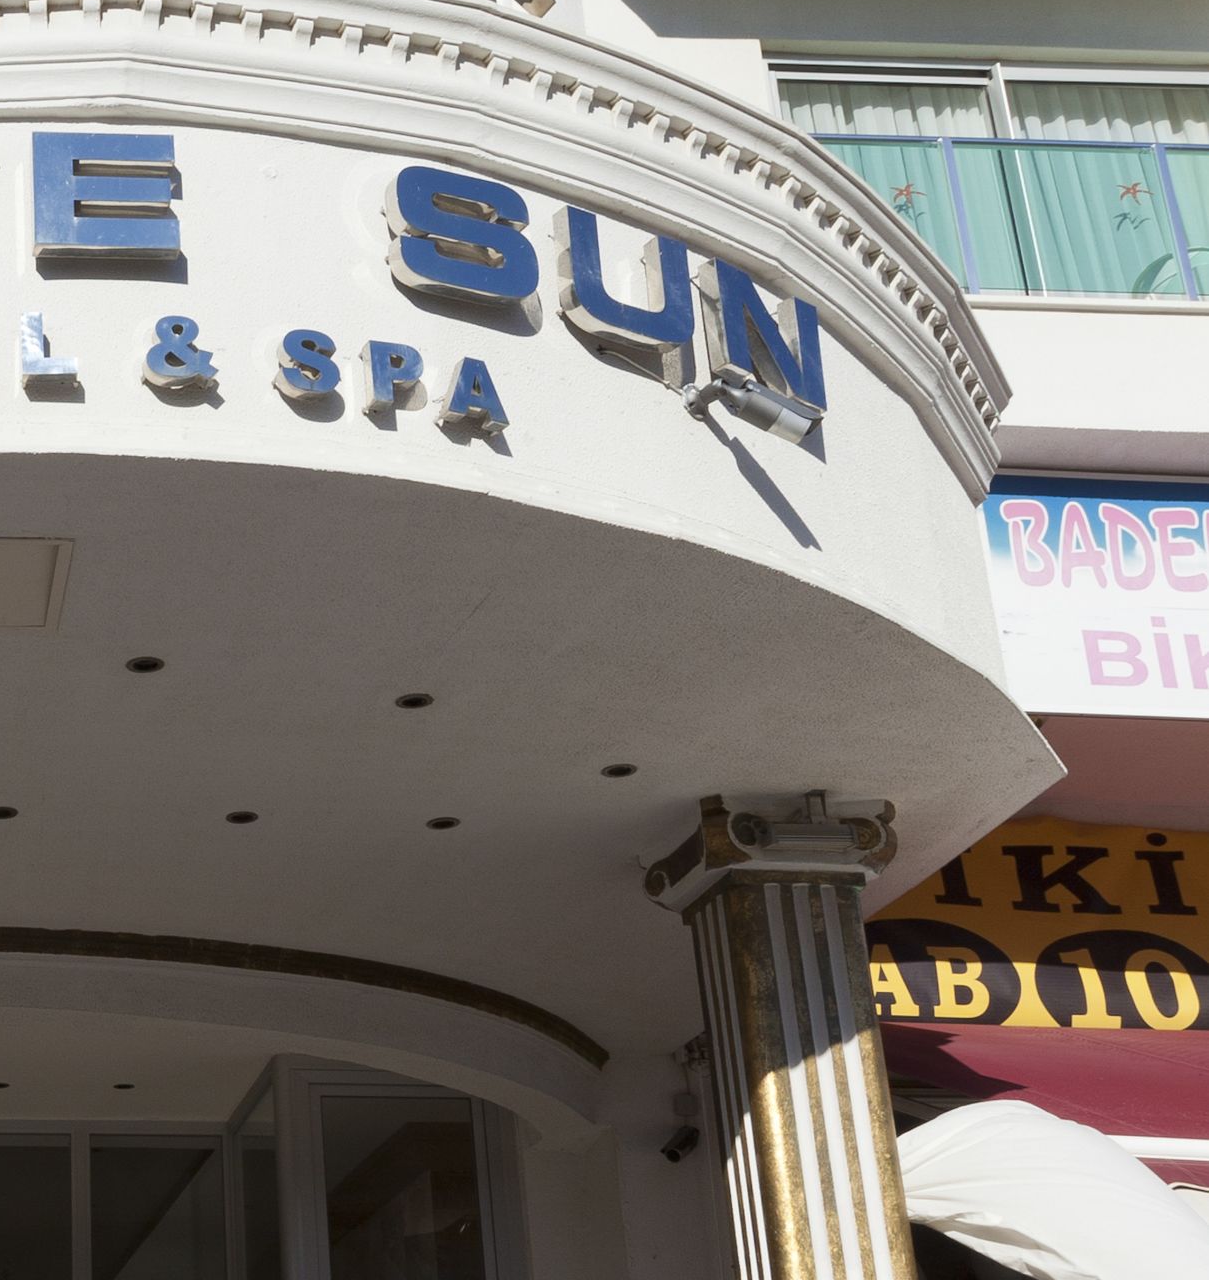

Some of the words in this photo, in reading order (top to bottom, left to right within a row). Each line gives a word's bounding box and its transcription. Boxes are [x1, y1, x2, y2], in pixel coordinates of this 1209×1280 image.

[385, 166, 827, 414] SUN
[144, 315, 219, 389] &
[274, 328, 509, 436] SPA
[1000, 500, 1209, 593] BADE
[1059, 947, 1201, 1031] 10
